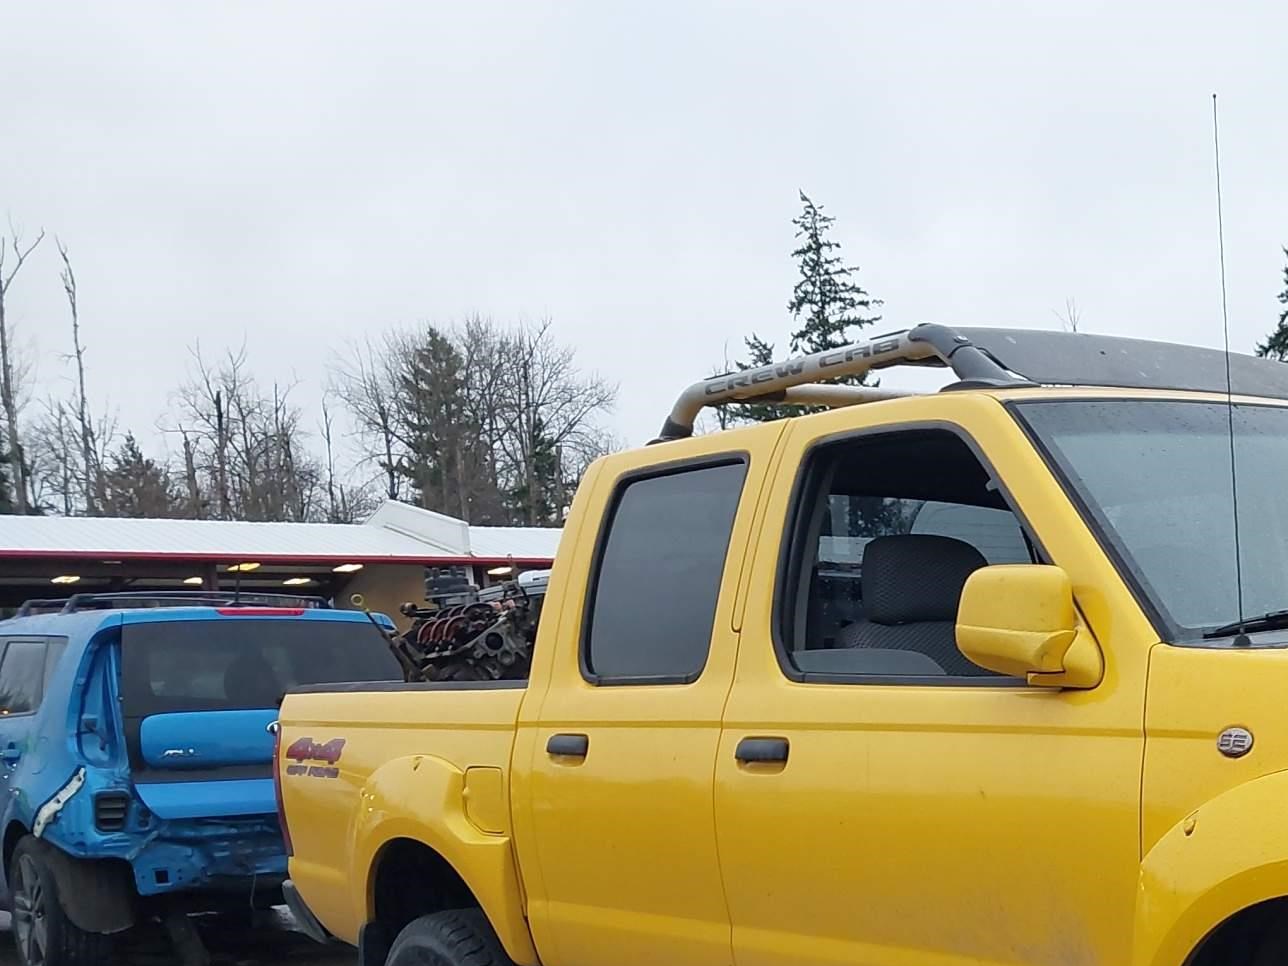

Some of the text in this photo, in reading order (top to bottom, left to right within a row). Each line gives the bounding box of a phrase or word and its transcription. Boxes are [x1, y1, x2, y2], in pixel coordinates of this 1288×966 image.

[704, 337, 900, 396] CREW CAB
[1219, 733, 1249, 749] SE
